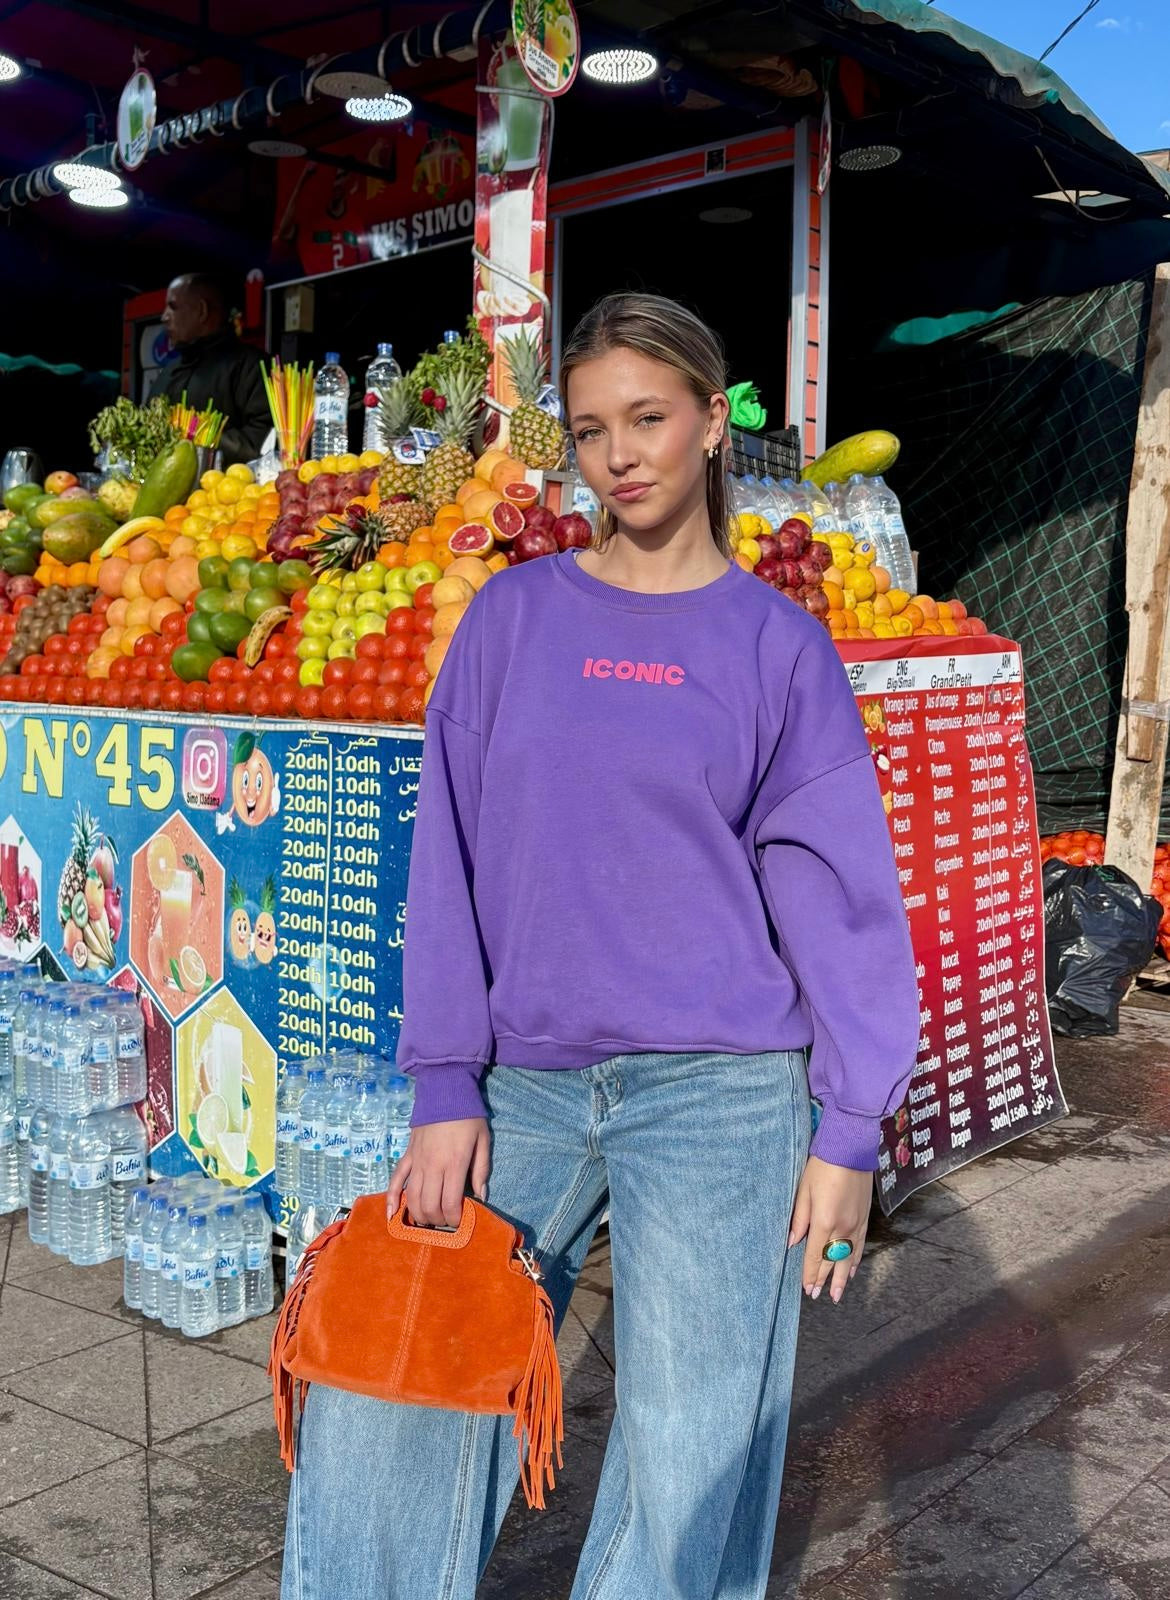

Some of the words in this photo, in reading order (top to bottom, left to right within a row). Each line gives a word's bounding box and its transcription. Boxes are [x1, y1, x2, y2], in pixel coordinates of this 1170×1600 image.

[412, 198, 475, 240] SIMO
[583, 658, 685, 685] ICONIC
[850, 664, 865, 680] ESP
[896, 660, 909, 677] ENG
[947, 658, 956, 673] FR
[886, 676, 916, 692] Big/Small
[930, 672, 972, 689] Grand/Petit
[884, 697, 904, 716] Orange
[904, 694, 919, 715] juice
[925, 694, 935, 708] Jus
[887, 719, 914, 740] Grapefruit
[925, 714, 963, 735] Pamplemousse
[963, 713, 981, 727] 20dh
[983, 710, 1000, 725] 10dh
[288, 730, 329, 752] كبير
[336, 735, 378, 755] صغير
[889, 744, 908, 760] Lemon
[928, 738, 945, 755] Citron
[966, 733, 985, 748] 20dh
[986, 730, 1003, 746] 10dh
[285, 752, 328, 771] 20dh
[334, 755, 380, 774] 10dh
[892, 765, 908, 787] Apple
[931, 763, 952, 779] Pomme
[969, 757, 986, 772] 20dh
[989, 753, 1006, 769] 10dh
[284, 772, 328, 792] 20dh
[335, 776, 381, 796] 10dh
[893, 791, 914, 809] Banana
[933, 785, 953, 801] Banane
[971, 778, 988, 793] 20dh
[990, 774, 1006, 790] 10dh
[284, 794, 327, 814] 20dh
[334, 797, 381, 819] 10dh
[893, 815, 911, 834] Peach
[972, 801, 989, 817] 20dh
[991, 797, 1007, 813] 10dh
[283, 815, 327, 836] 20dh
[334, 820, 380, 841] 10dh
[894, 842, 914, 859] Prunes
[934, 833, 960, 849] Pruneaux
[972, 825, 990, 840] 20dh
[991, 820, 1007, 836] 10dh
[282, 839, 325, 859] 20dh
[333, 844, 379, 866] 10dh
[935, 853, 964, 876] Gingembre
[972, 849, 990, 866] 20dh
[991, 845, 1008, 861] 10dh
[281, 860, 325, 881] 20dh
[331, 866, 378, 888] 10dh
[936, 883, 949, 901] Kaki
[974, 873, 991, 890] 20dh
[992, 868, 1010, 884] 10dh
[280, 886, 323, 908] 20dh
[331, 893, 377, 916] 10dh
[938, 905, 950, 923] Kiwi
[975, 895, 992, 912] 20dh
[994, 889, 1010, 906] 10dh
[280, 911, 322, 933] 20dh
[330, 919, 376, 942] 10dh
[940, 928, 954, 946] Poire
[976, 916, 993, 933] 20dh
[994, 911, 1011, 927] 10dh
[279, 937, 321, 959] 20dh
[330, 946, 375, 970] 10dh
[941, 950, 960, 970] Avocat
[978, 939, 994, 957] 20dh
[996, 933, 1012, 950] 10dh
[278, 961, 321, 984] 20dh
[329, 971, 375, 996] 10dh
[942, 974, 962, 994] Papaye
[978, 962, 995, 980] 20dh
[997, 956, 1013, 973] 10dh
[278, 987, 321, 1012] 20dh
[329, 995, 375, 1021] 10dh
[944, 997, 963, 1016] Ananas
[980, 985, 996, 1003] 20dh
[998, 978, 1014, 996] 10dh
[278, 1011, 321, 1036] 20dh
[329, 1020, 375, 1045] 10dh
[945, 1018, 967, 1041] Grenade
[980, 1006, 998, 1025] 30dh
[999, 999, 1015, 1017] 15dh
[982, 1029, 1000, 1048] 20dh
[1001, 1022, 1017, 1040] 10dh
[278, 1035, 321, 1058] 20dh
[908, 1081, 936, 1105] Nectarine
[948, 1064, 973, 1087] Nectarine
[984, 1050, 1001, 1069] 20dh
[1002, 1042, 1019, 1060] 10dh
[910, 1100, 941, 1126] Strawberry
[949, 1089, 965, 1108] Fraise
[985, 1071, 1002, 1090] 20dh
[1004, 1062, 1021, 1081] 10dh
[912, 1127, 931, 1147] Mango
[987, 1091, 1006, 1111] 20dh
[1006, 1082, 1024, 1102] 10dh
[325, 1132, 348, 1147] Bahia
[913, 1147, 934, 1168] Dragon
[951, 1128, 972, 1149] Dragon
[990, 1112, 1009, 1131] 30dh
[1010, 1103, 1029, 1122] 15dh
[115, 1158, 141, 1175] Bahia
[185, 1267, 209, 1282] Bahia
